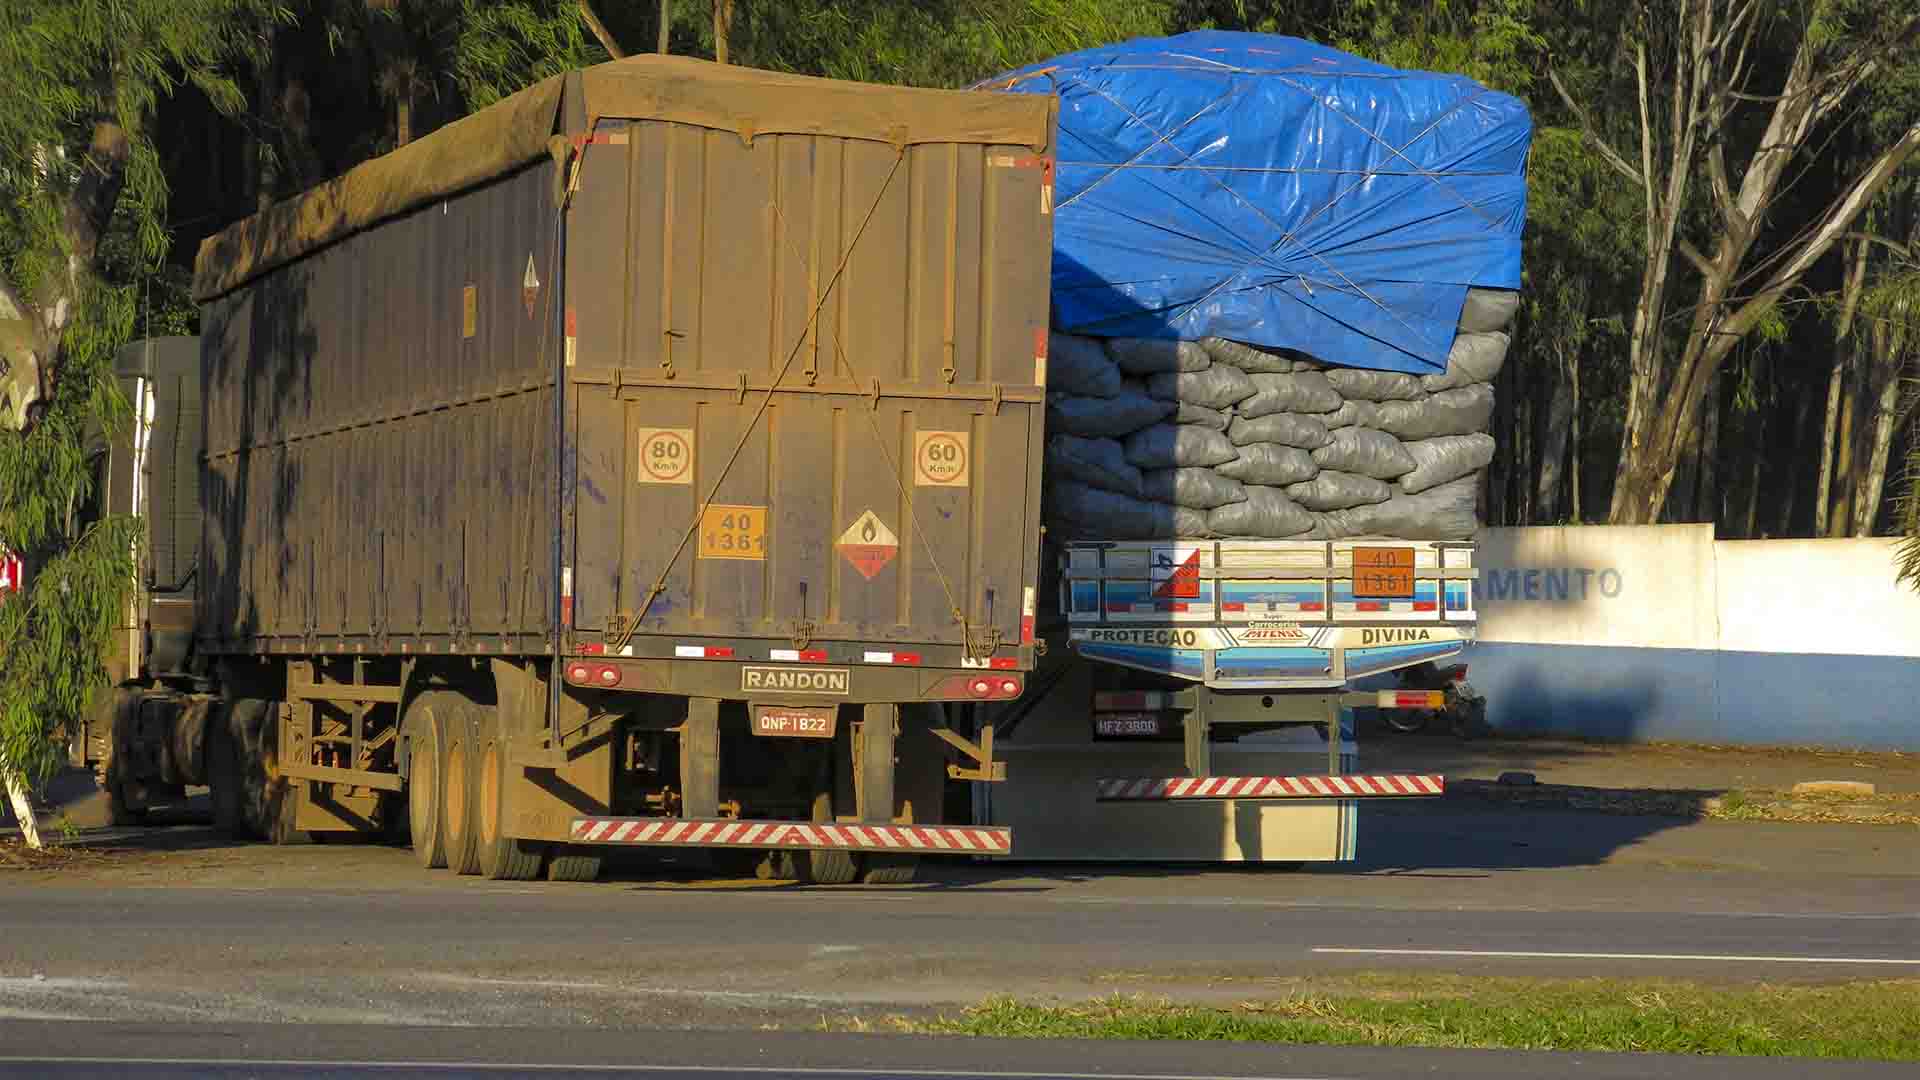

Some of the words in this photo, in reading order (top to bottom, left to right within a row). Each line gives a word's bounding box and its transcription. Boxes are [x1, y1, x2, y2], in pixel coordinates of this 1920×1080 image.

[652, 441, 680, 459] 80
[928, 443, 956, 462] 60
[721, 513, 751, 530] 40
[706, 532, 764, 551] 1361
[1374, 551, 1396, 568] 40
[1363, 574, 1408, 592] 1361
[1361, 628, 1430, 644] DIVINA
[746, 671, 845, 690] RANDON
